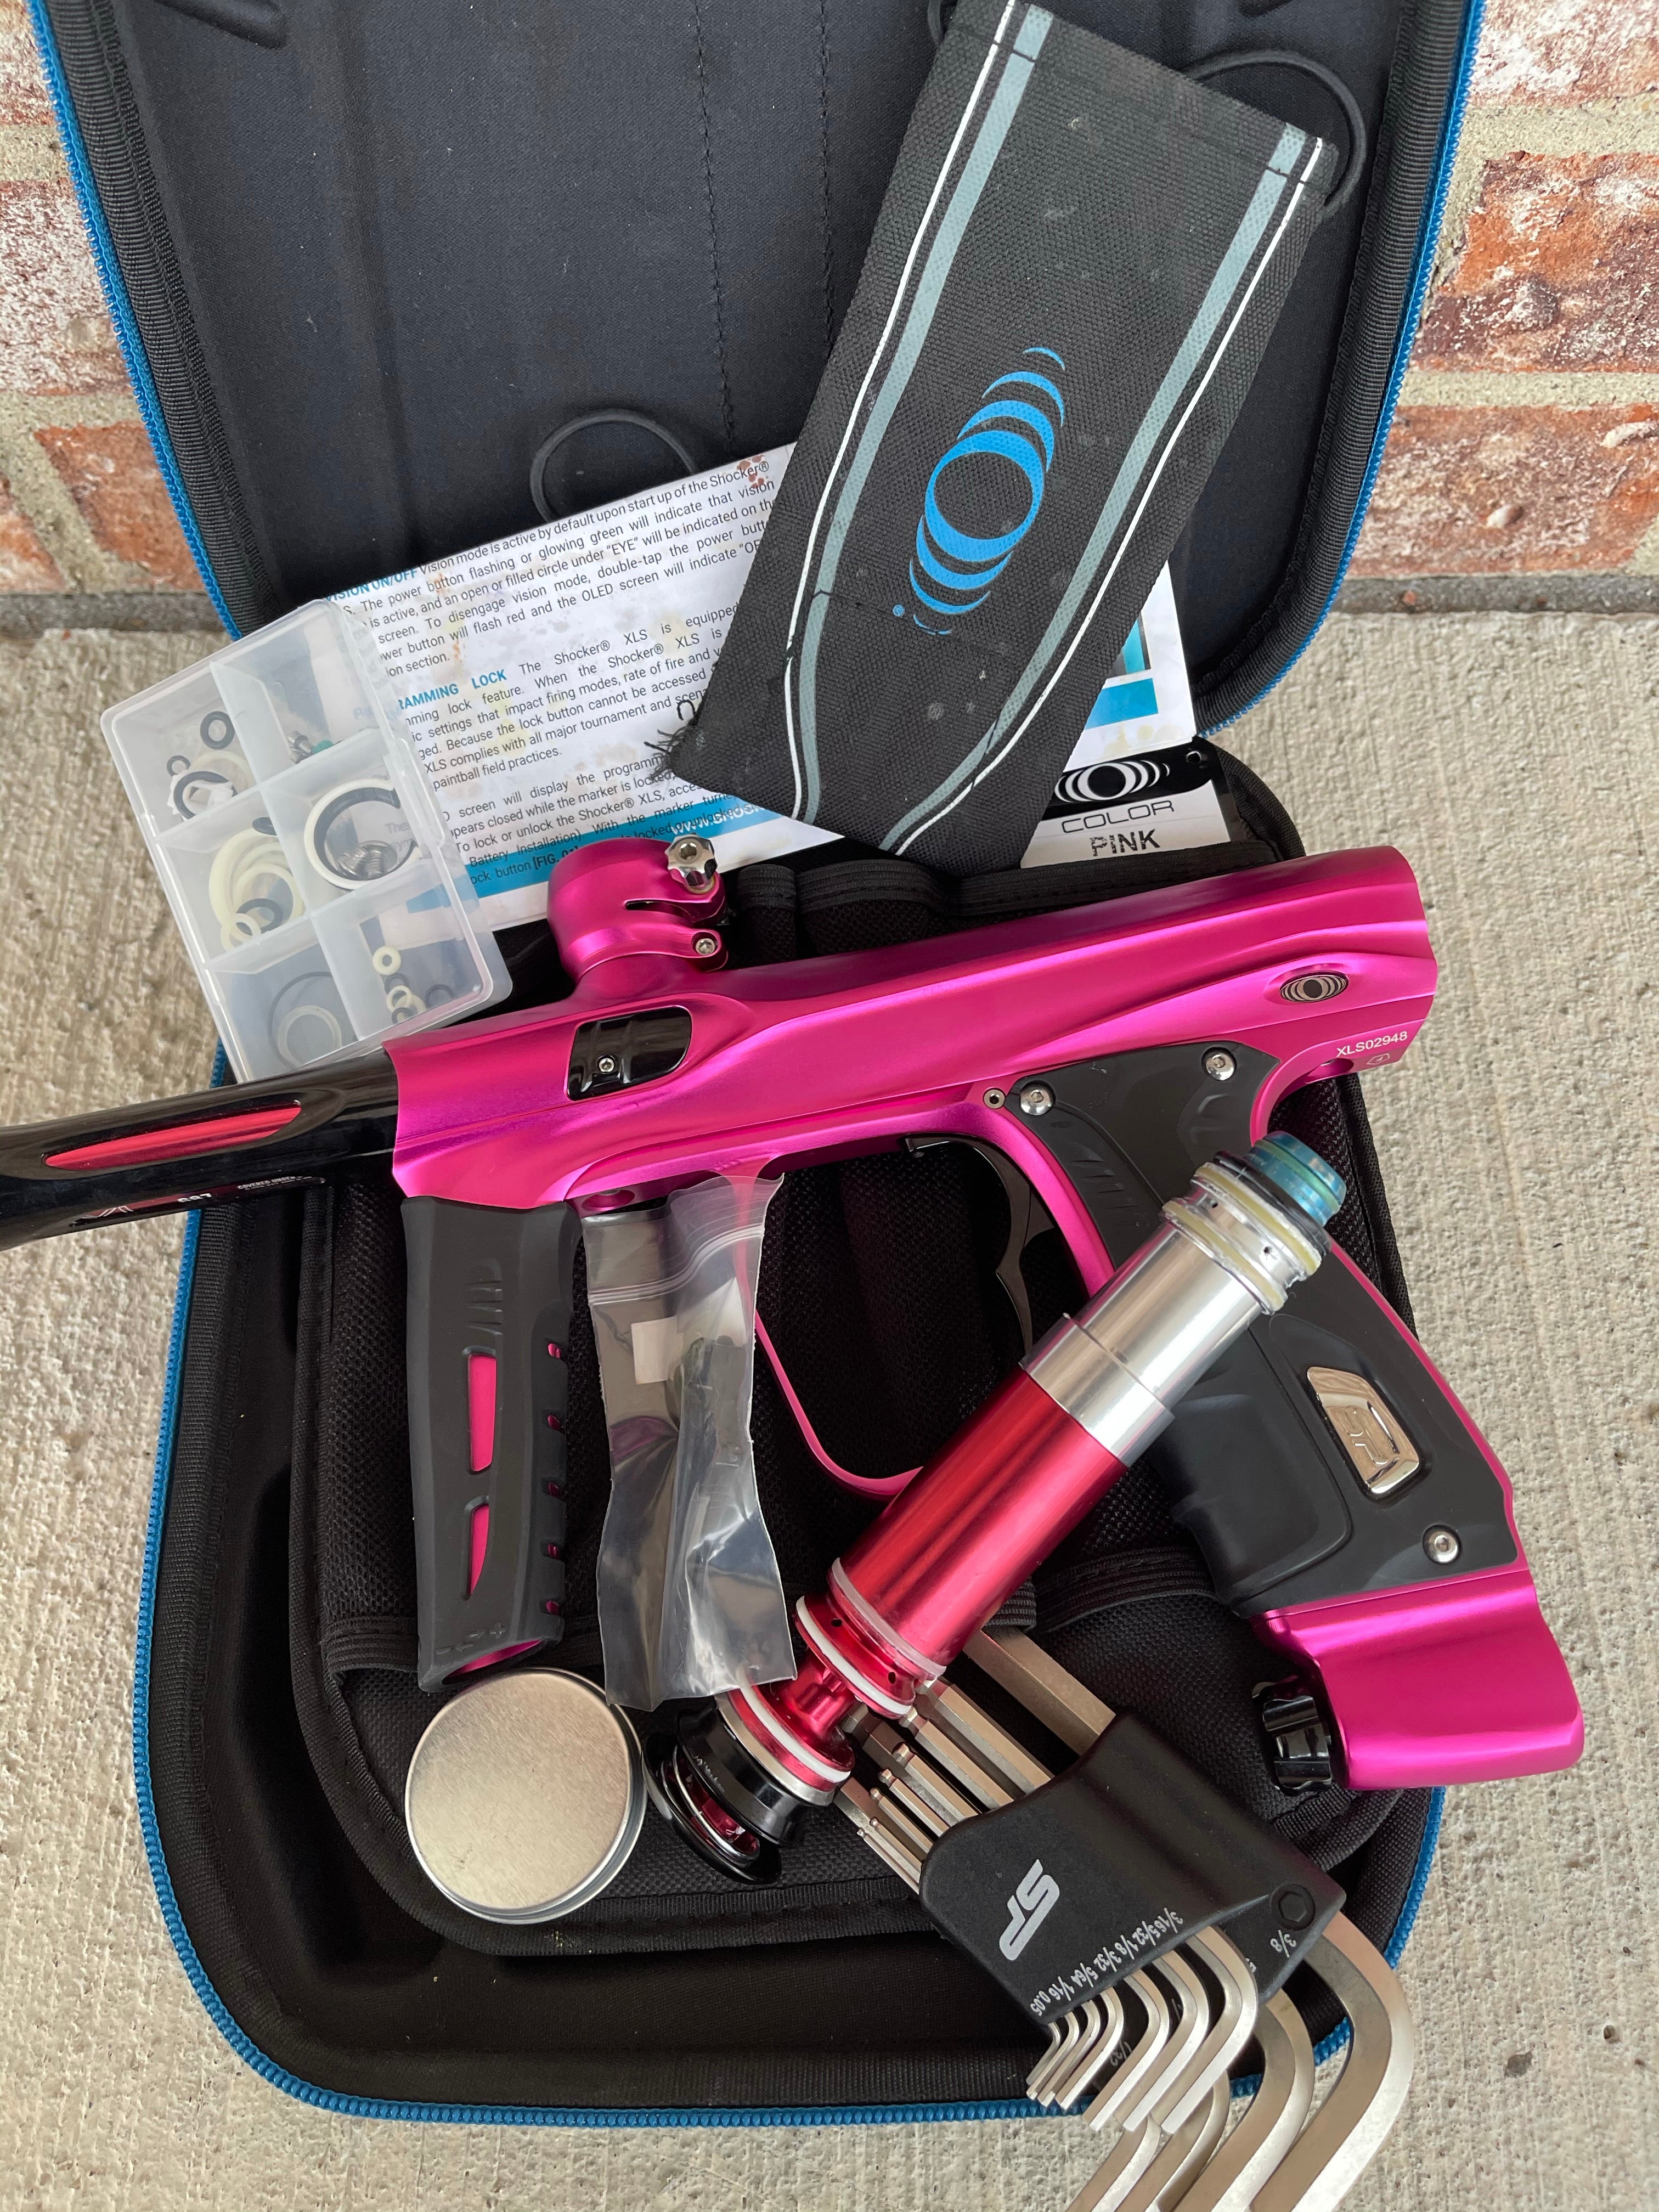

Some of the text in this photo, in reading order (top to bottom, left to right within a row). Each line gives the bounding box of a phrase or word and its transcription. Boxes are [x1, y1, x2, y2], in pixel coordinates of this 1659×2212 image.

[360, 599, 383, 612] The
[388, 586, 421, 607] power
[426, 574, 465, 592] button
[469, 558, 516, 579] flashing
[521, 552, 532, 563] or
[539, 537, 585, 561] glowing
[590, 526, 624, 546] green
[628, 515, 650, 531] will
[654, 502, 703, 523] indicate
[707, 491, 733, 507] that
[738, 480, 775, 499] vision
[418, 557, 455, 575] Vision
[456, 547, 489, 565] mode
[490, 543, 500, 554] is
[502, 533, 537, 550] active
[538, 528, 551, 540] by
[554, 514, 595, 534] default
[596, 505, 627, 523] upon
[628, 495, 656, 512] start
[657, 492, 672, 504] up
[674, 483, 686, 498] of
[688, 481, 708, 494] the
[369, 617, 380, 628] is
[382, 607, 419, 624] active,
[420, 596, 442, 613] and
[444, 595, 459, 606] an
[461, 585, 489, 601] open
[492, 580, 503, 591] or
[505, 568, 535, 587] filled
[537, 560, 569, 578] circle
[571, 550, 604, 567] under
[642, 529, 663, 546] will
[664, 528, 681, 540] be
[682, 507, 738, 534] indicated
[741, 505, 757, 517] on
[378, 626, 419, 644] screen.
[424, 618, 441, 629] To
[448, 599, 506, 623] disengage
[511, 586, 547, 603] vision
[554, 573, 591, 592] mode,
[597, 552, 662, 578] double-tap
[669, 544, 689, 557] the
[696, 531, 733, 552] power
[407, 636, 445, 653] button
[449, 625, 469, 644] will
[473, 617, 502, 634] flash
[506, 608, 526, 624] red
[531, 600, 553, 617] and
[557, 596, 577, 609] the
[582, 583, 613, 601] OLED
[619, 572, 659, 590] screen
[663, 561, 685, 577] will
[689, 549, 737, 571] indicate
[405, 653, 450, 672] section.
[447, 628, 722, 714] lock feature. When the Shocker® XLS is
[471, 669, 507, 690] LOCK
[518, 662, 541, 675] The
[554, 640, 611, 665] Shocker®
[623, 629, 648, 645] XLS
[661, 623, 672, 634] is
[428, 719, 472, 738] settings
[477, 709, 500, 724] that
[505, 696, 544, 716] impact
[546, 689, 576, 704] firing
[578, 677, 621, 695] modes,
[623, 669, 647, 682] rate
[650, 661, 662, 675] of
[664, 658, 685, 670] fire
[688, 647, 710, 664] and
[446, 730, 493, 751] Because
[496, 724, 515, 736] the
[518, 714, 544, 730] lock
[546, 704, 584, 722] button
[588, 691, 628, 710] cannot
[631, 687, 647, 698] be
[651, 667, 707, 693] accessed
[424, 695, 672, 774] XLS complies with all major tournament and
[433, 748, 562, 792] paintball field practices.
[459, 801, 496, 817] screen
[503, 791, 522, 805] will
[530, 781, 568, 798] display
[576, 774, 595, 786] the
[473, 833, 498, 849] lock
[501, 831, 512, 842] or
[516, 819, 554, 838] unlock
[556, 815, 575, 827] the
[578, 797, 634, 821] Shocker®
[637, 790, 665, 805] XLS,
[487, 808, 524, 827] closed
[525, 801, 555, 817] while
[556, 797, 576, 809] the
[578, 785, 618, 804] marker
[620, 781, 631, 792] is
[1062, 800, 1175, 833] COLOR
[470, 849, 509, 867] Battery
[592, 820, 619, 836] With
[627, 812, 646, 826] the
[654, 800, 694, 820] marker
[1090, 829, 1160, 856] PINK
[496, 861, 531, 878] button
[1336, 1031, 1408, 1058] XLS02948
[1093, 1946, 1122, 1972] 3/32
[1114, 1934, 1138, 1960] 1/8
[1270, 1929, 1296, 1958] 3/8
[1048, 1976, 1075, 2001] 1/16
